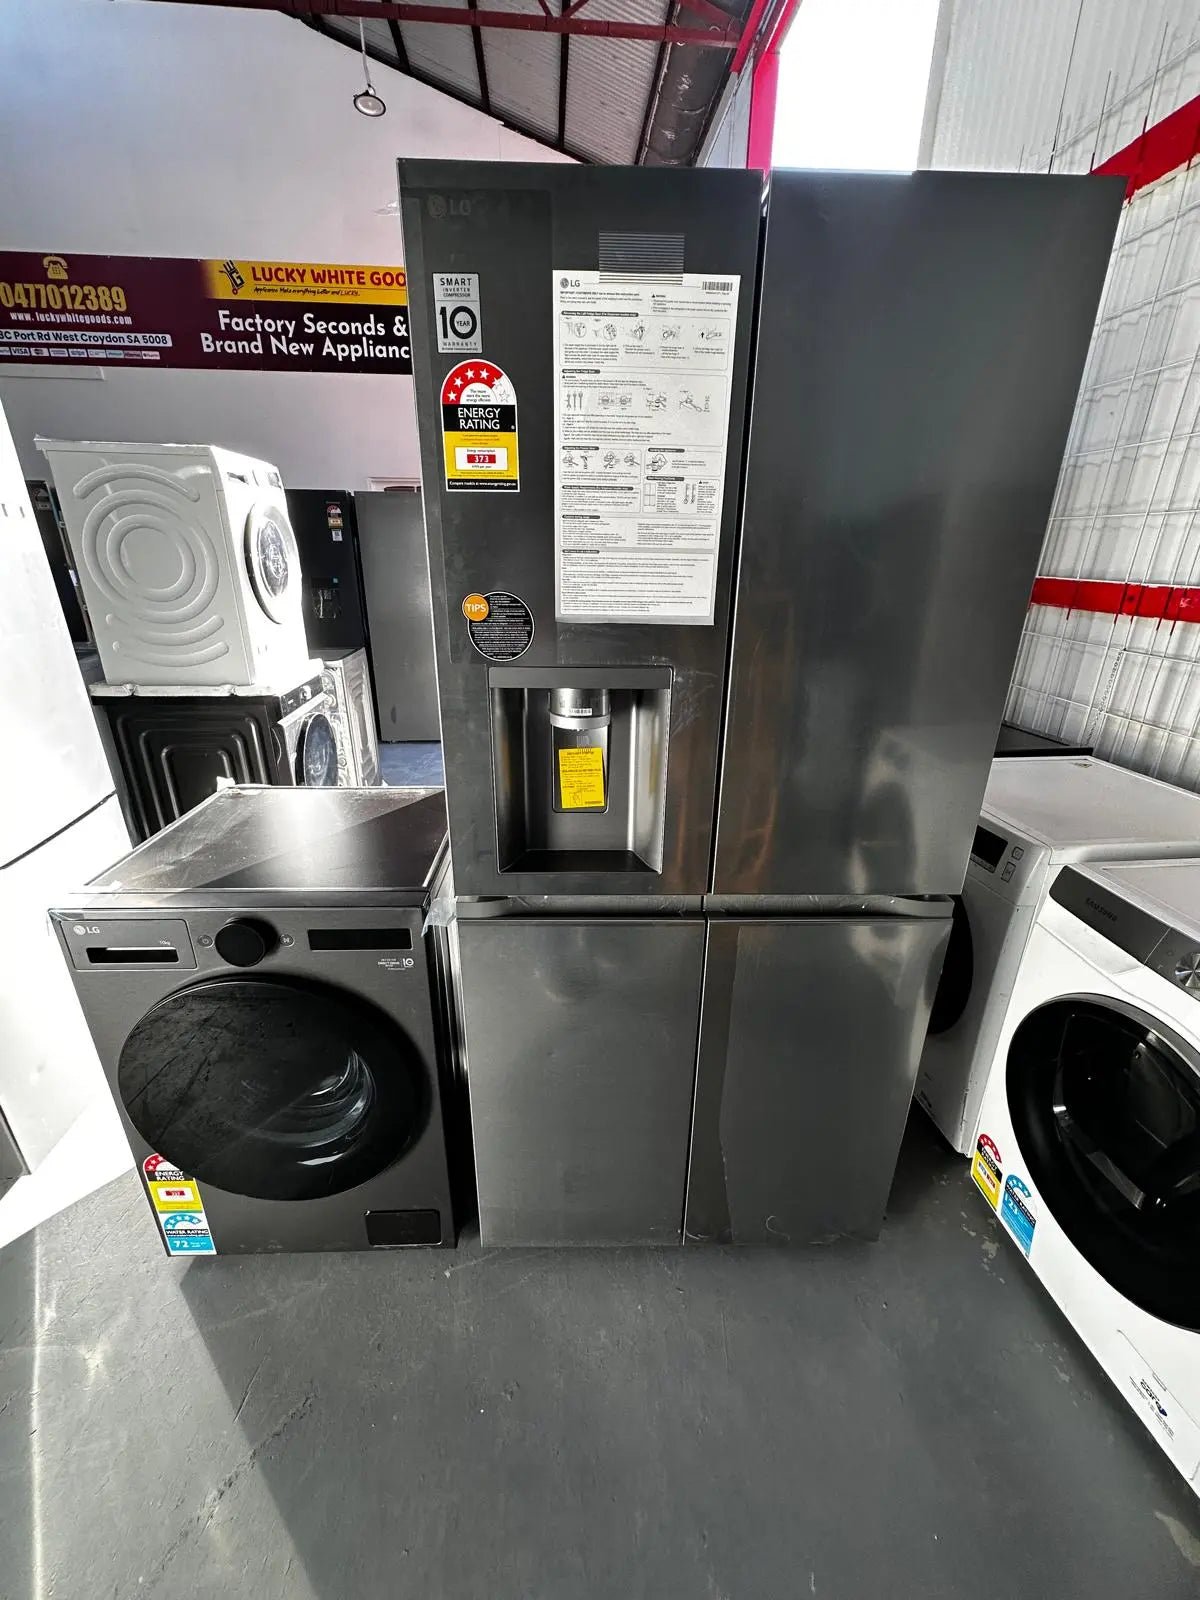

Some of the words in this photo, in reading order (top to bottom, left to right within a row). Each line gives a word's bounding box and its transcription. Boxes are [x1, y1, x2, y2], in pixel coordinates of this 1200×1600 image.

[251, 266, 306, 283] LUCKY
[310, 268, 366, 286] WHITE
[439, 277, 472, 287] SMART
[570, 279, 581, 288] LG
[0, 282, 128, 313] 0477012389
[217, 309, 296, 338] Factory
[303, 312, 386, 336] Seconds
[392, 315, 409, 337] &
[439, 305, 478, 340] 10
[14, 331, 37, 342] Port
[38, 331, 51, 342] Rd
[51, 331, 79, 343] West
[79, 333, 125, 346] Croydon
[126, 335, 141, 345] SA
[142, 335, 169, 346] 5008
[12, 347, 29, 356] VISA
[200, 332, 263, 355] Brand
[270, 334, 315, 356] New
[321, 335, 411, 363] Applianc
[457, 407, 501, 419] ENERGY
[459, 419, 501, 430] RATING
[474, 455, 489, 463] 373
[465, 602, 487, 613] TIPS
[86, 926, 101, 934] LG
[173, 1240, 190, 1248] 72
